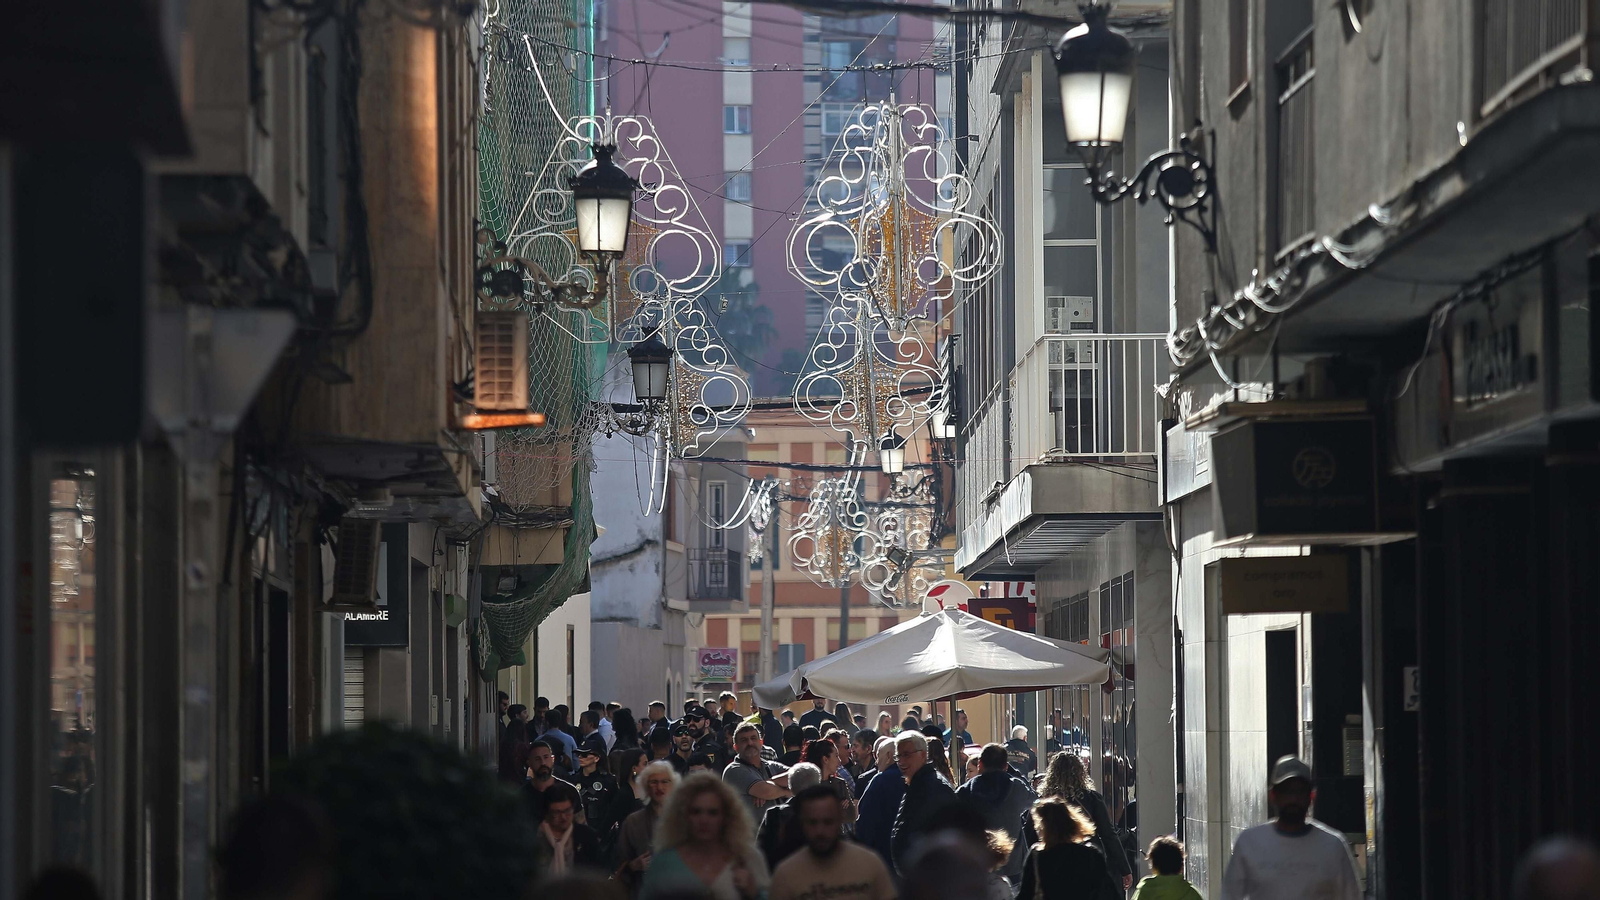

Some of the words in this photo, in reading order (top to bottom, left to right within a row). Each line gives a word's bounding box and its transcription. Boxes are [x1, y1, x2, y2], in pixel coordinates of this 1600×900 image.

[1243, 569, 1323, 583] compramos
[1272, 588, 1297, 598] oro
[344, 610, 389, 621] ALAMBRE
